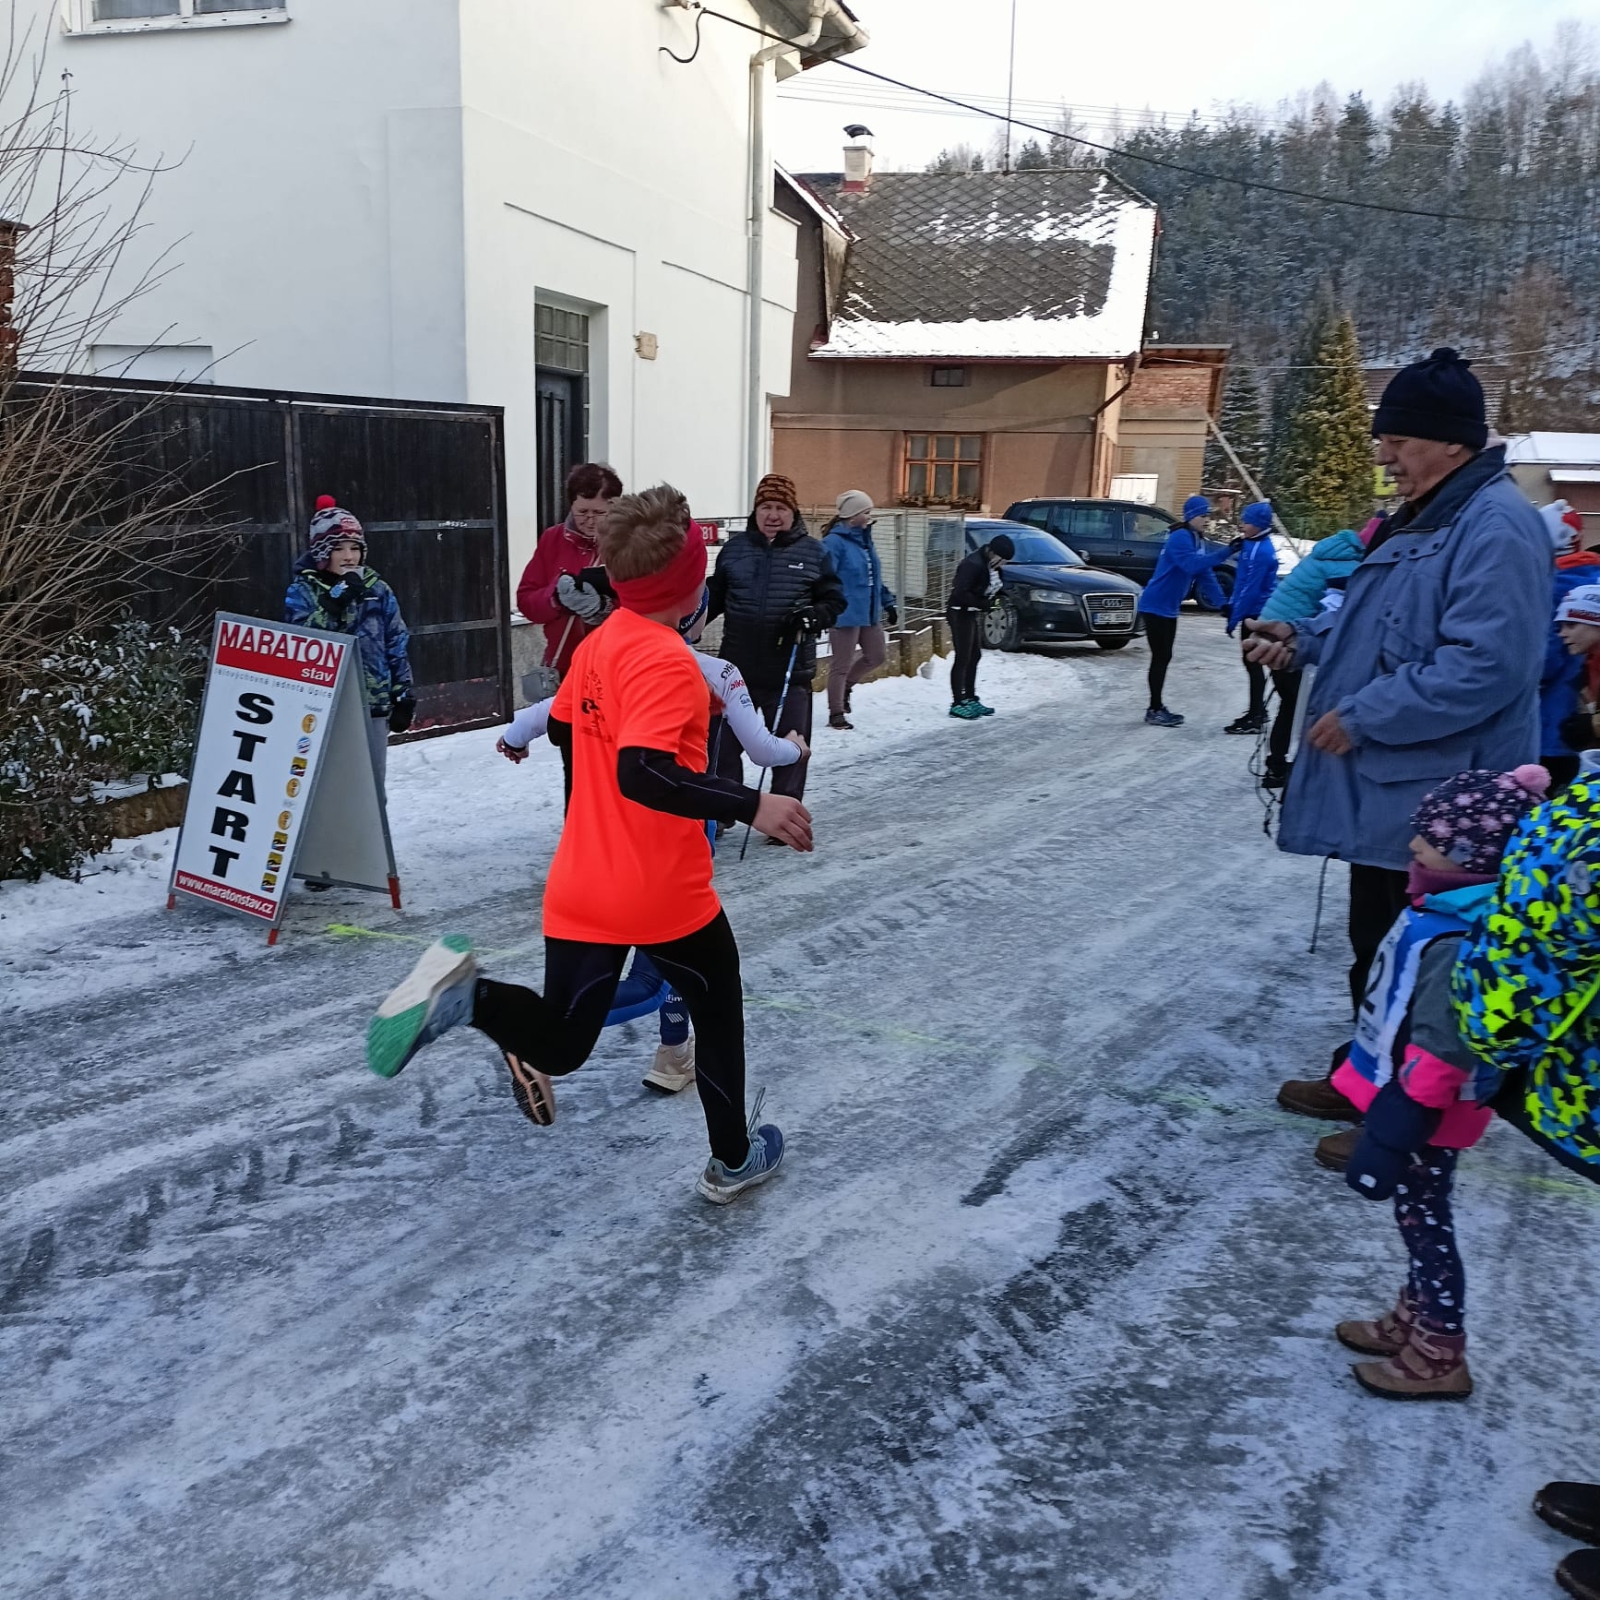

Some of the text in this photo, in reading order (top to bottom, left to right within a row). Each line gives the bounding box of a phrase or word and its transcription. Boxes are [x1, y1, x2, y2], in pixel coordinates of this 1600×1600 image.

[700, 526, 714, 541] 81
[219, 621, 344, 668] MARATON
[301, 666, 335, 683] stav
[208, 691, 276, 879] START
[178, 874, 275, 914] www.maratonstav.cz
